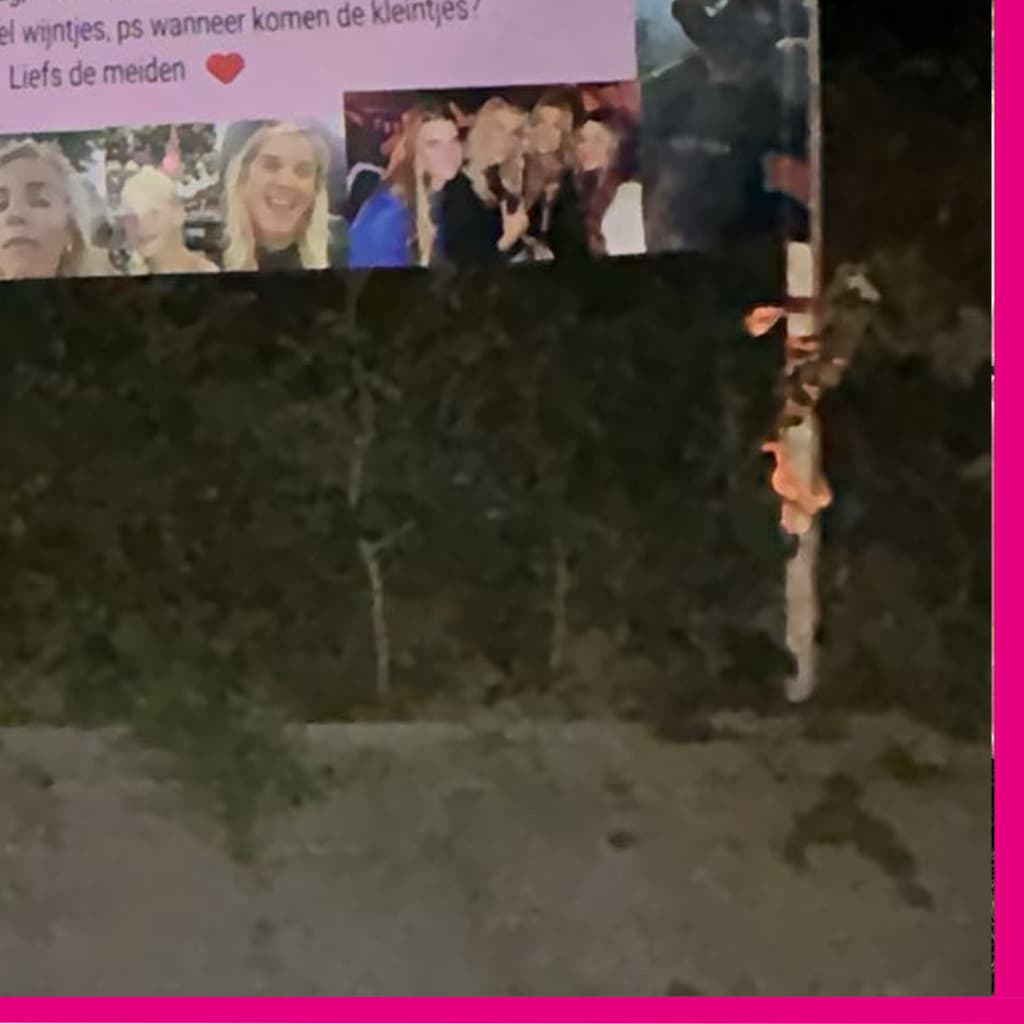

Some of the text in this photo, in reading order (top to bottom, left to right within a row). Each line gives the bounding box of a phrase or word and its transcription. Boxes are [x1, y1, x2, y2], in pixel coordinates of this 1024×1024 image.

[23, 17, 112, 51] wijntjes,
[117, 18, 144, 46] ps
[150, 13, 245, 38] wanneer
[251, 6, 330, 32] komen
[336, 1, 365, 28] de
[9, 56, 186, 90] Liefs de meiden
